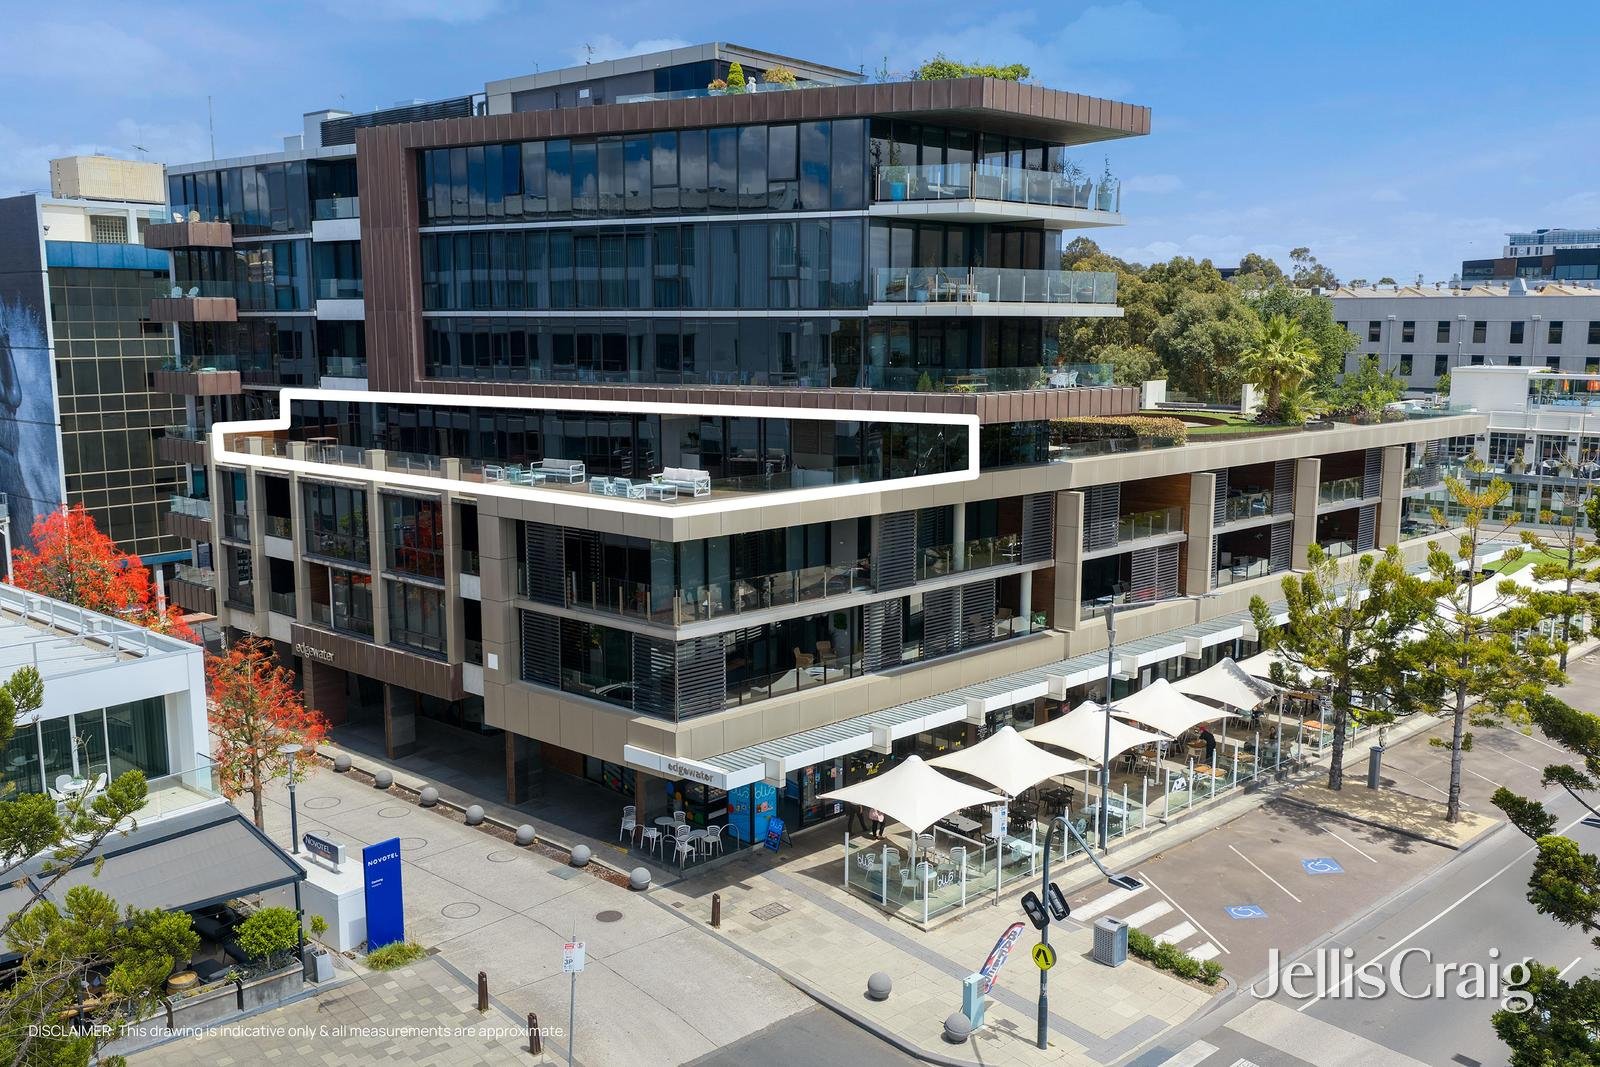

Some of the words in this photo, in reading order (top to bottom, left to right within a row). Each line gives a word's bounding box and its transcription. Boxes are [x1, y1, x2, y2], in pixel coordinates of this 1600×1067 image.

[295, 641, 336, 661] edgewater
[668, 763, 714, 782] edgewater
[305, 836, 331, 854] NOVOTEL
[367, 852, 399, 867] NOVOTEL
